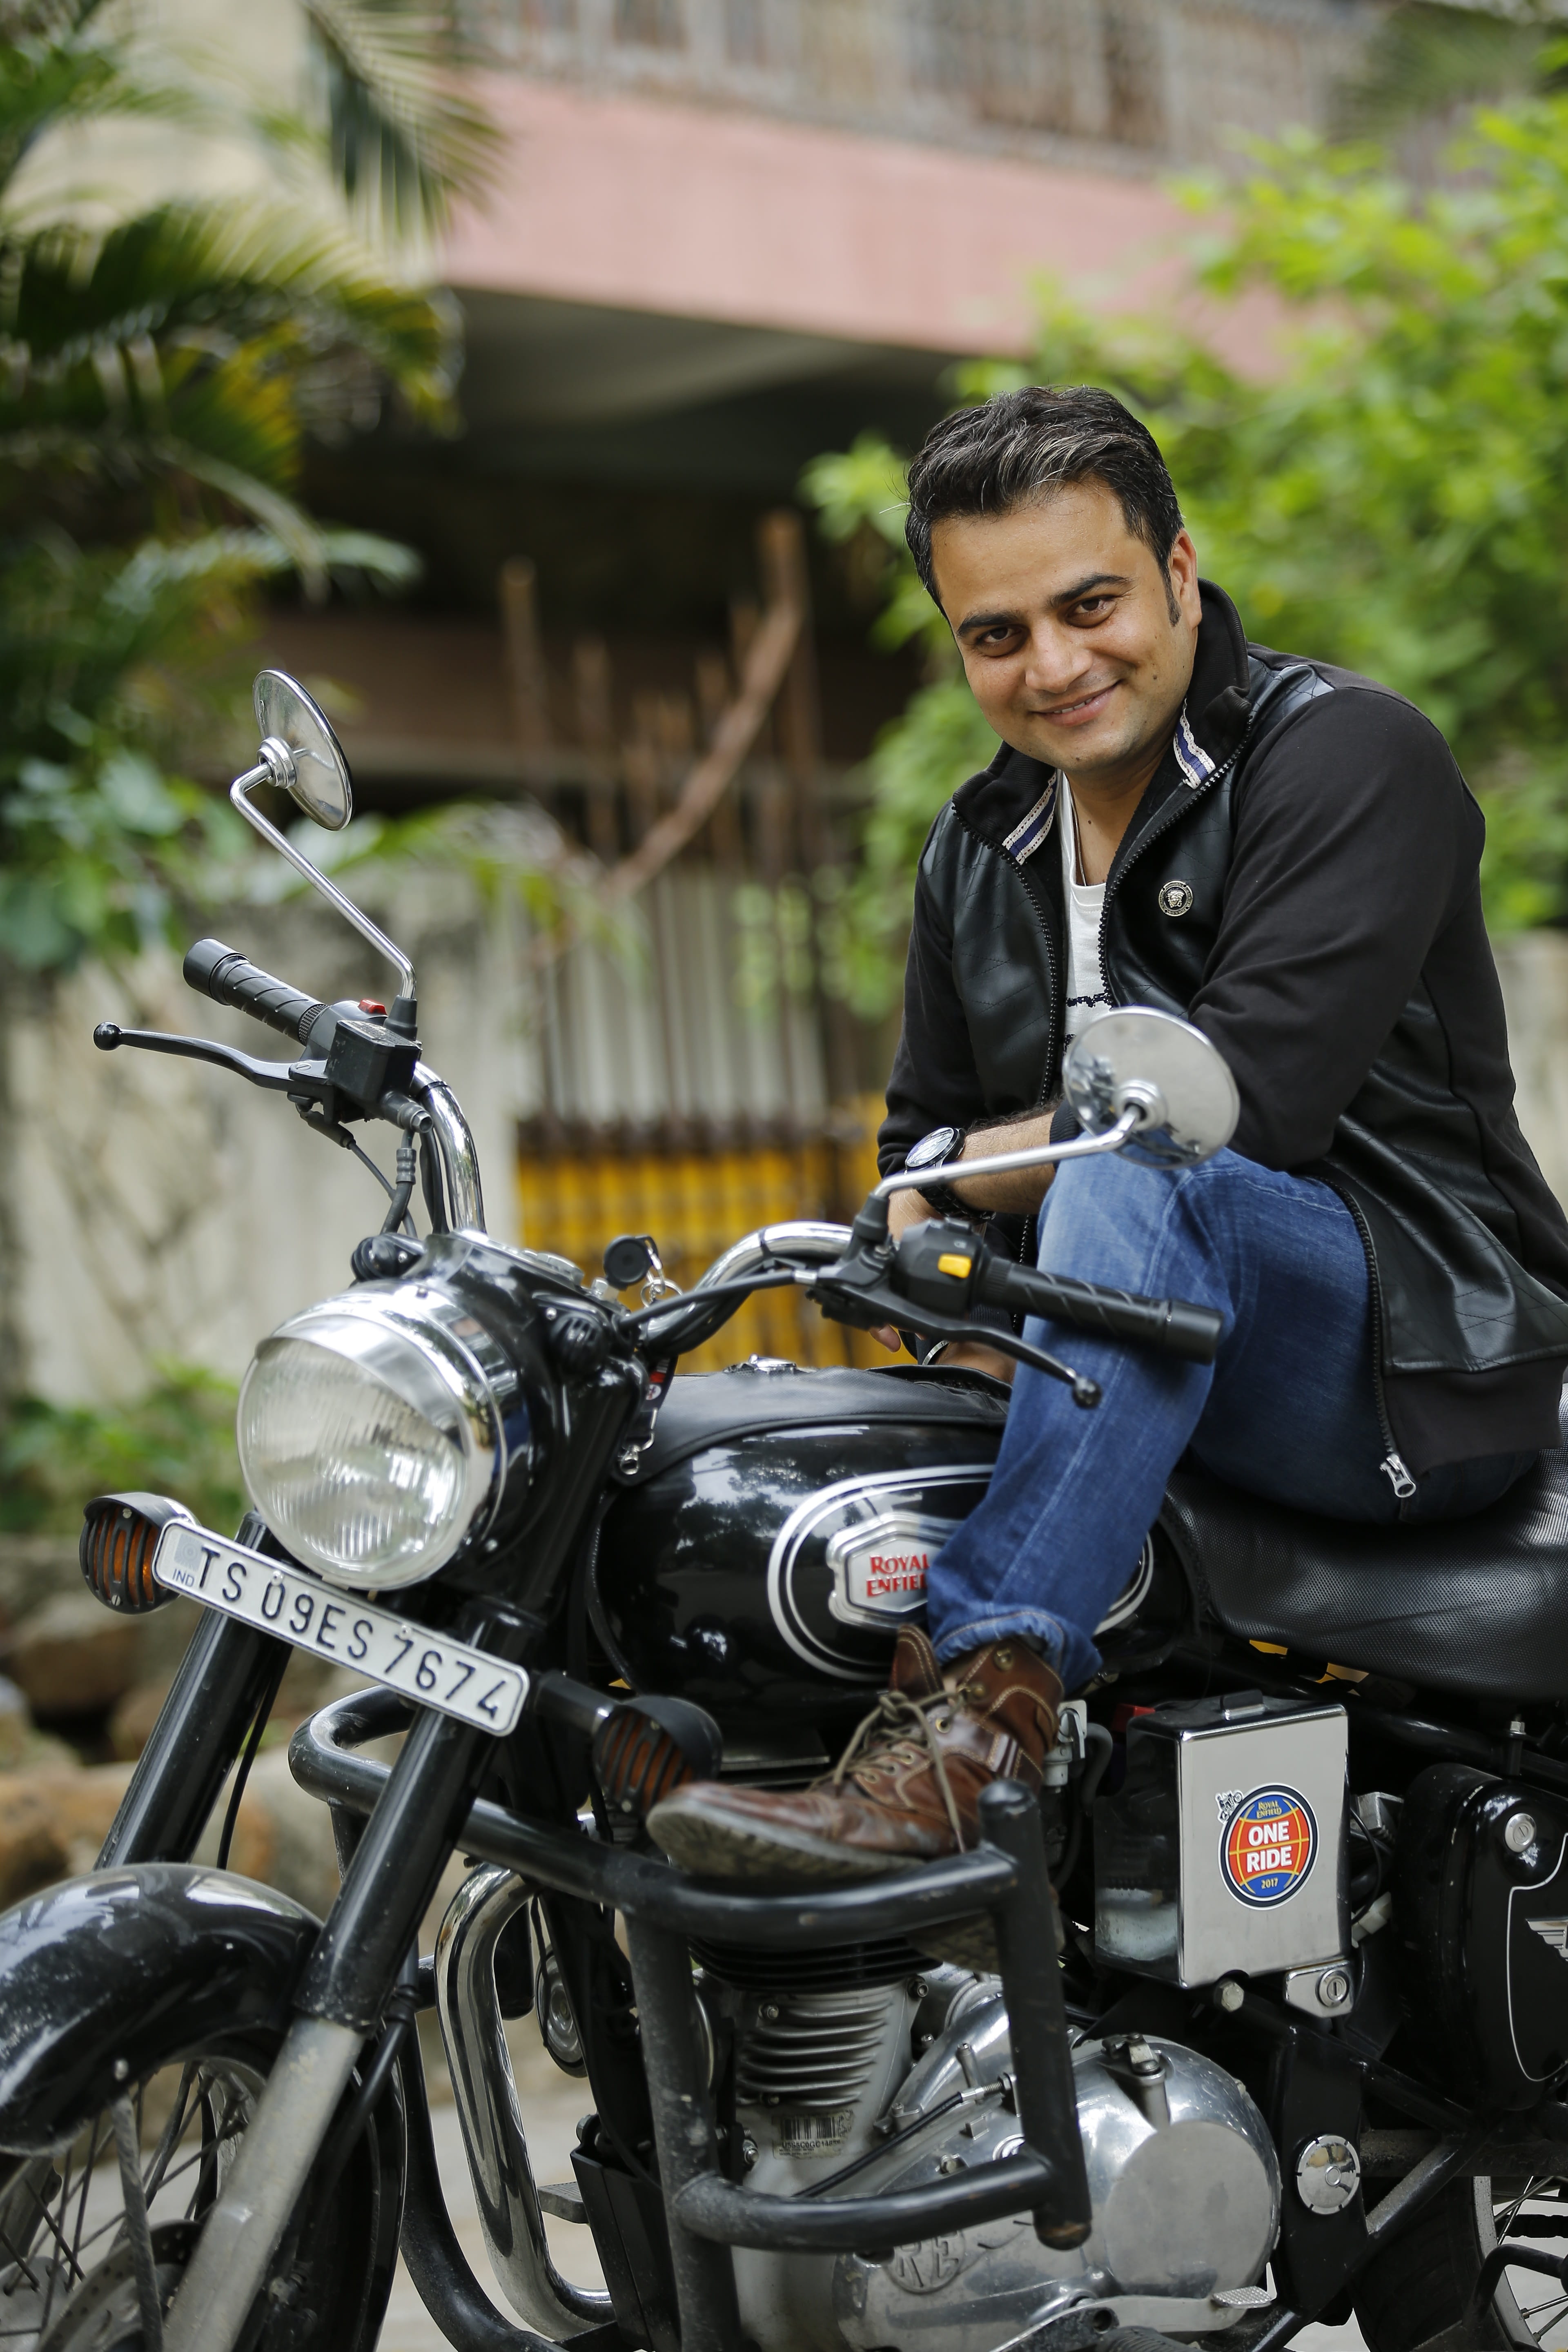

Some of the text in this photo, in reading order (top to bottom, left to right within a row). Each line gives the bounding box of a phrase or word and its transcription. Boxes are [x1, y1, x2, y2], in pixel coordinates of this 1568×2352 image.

[870, 1553, 930, 1575] ROYAL
[172, 1569, 194, 1587] IND
[866, 1573, 928, 1597] ENFIEL
[200, 1546, 506, 1719] TS 09ES 7674
[1256, 1807, 1282, 1819] ENFIELD
[1258, 1800, 1279, 1811] ROYAL
[1248, 1820, 1290, 1846] ONE
[1247, 1845, 1292, 1873] RIDE
[1261, 1878, 1279, 1889] 2017
